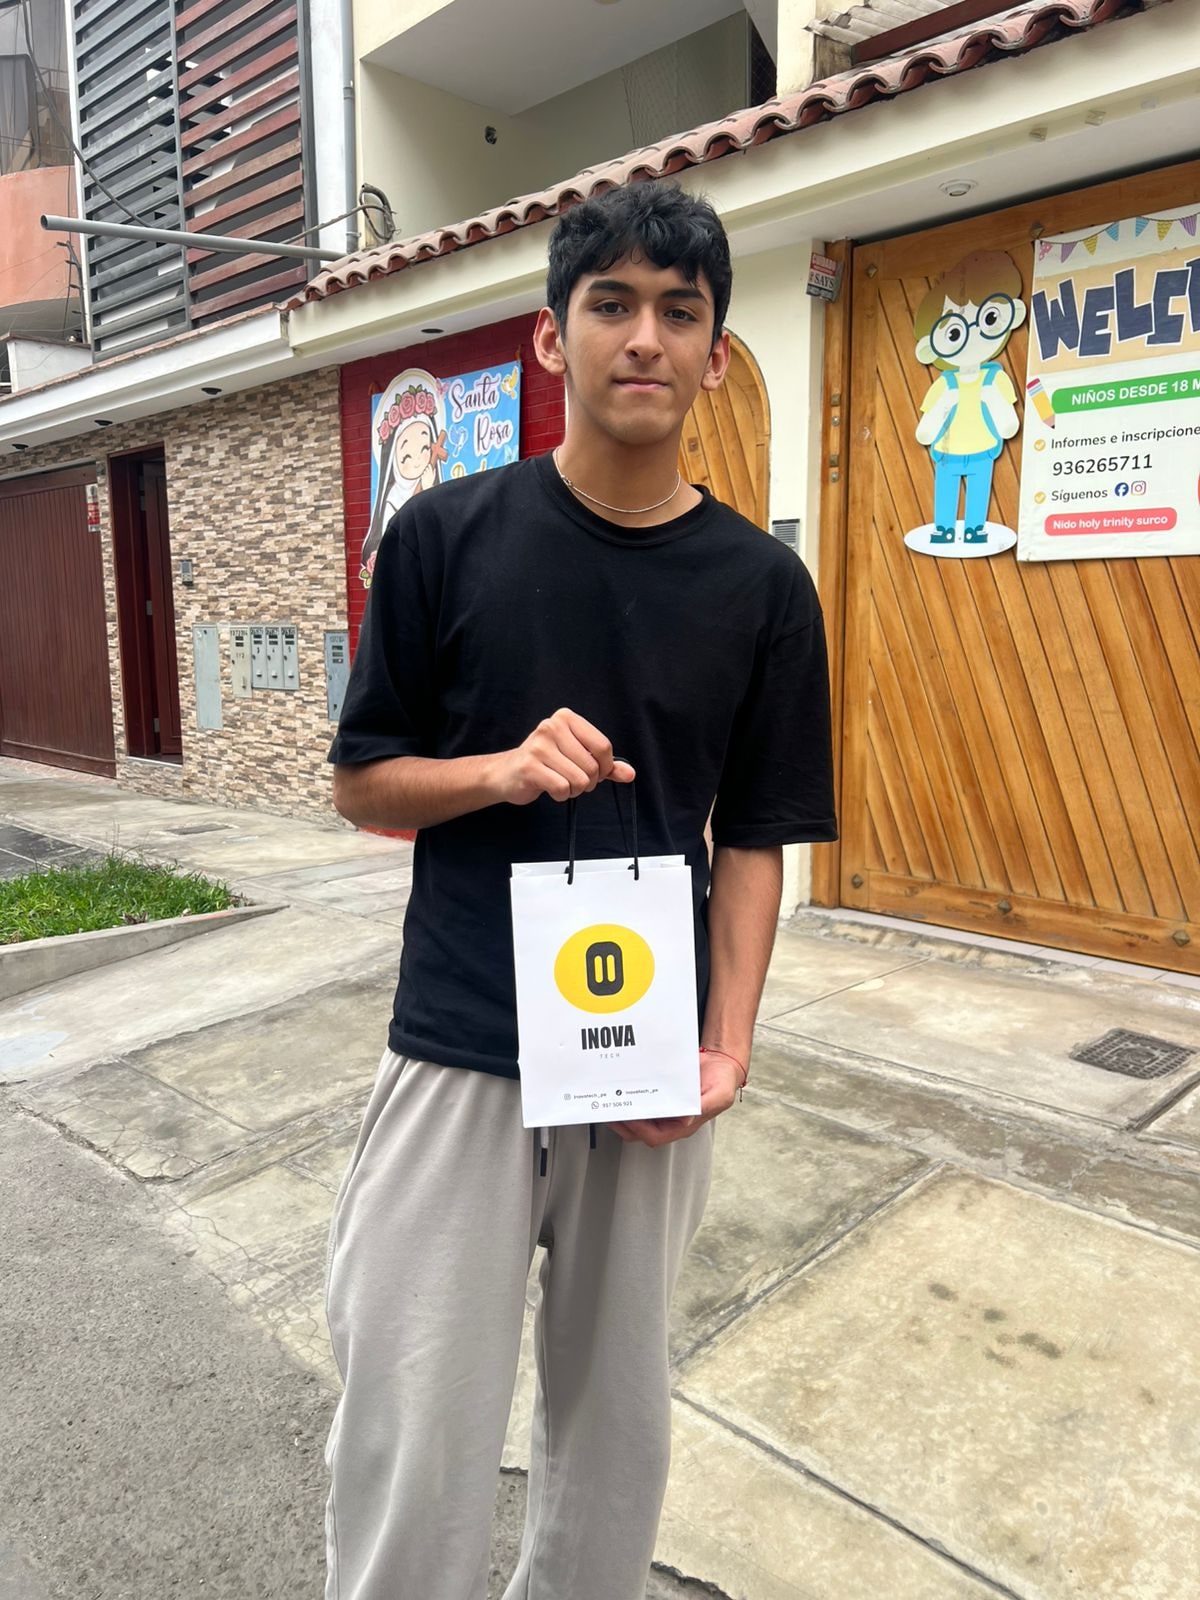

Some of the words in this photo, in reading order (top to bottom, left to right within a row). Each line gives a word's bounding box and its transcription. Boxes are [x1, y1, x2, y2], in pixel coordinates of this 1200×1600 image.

[451, 375, 500, 419] Santa
[1071, 389, 1115, 406] NIÑOS
[1119, 382, 1168, 400] DESDE
[1171, 379, 1188, 393] 18
[477, 416, 510, 452] Rosa
[1051, 435, 1106, 449] Informes
[1110, 434, 1118, 444] e
[1121, 425, 1200, 442] inscripcione
[1052, 454, 1152, 476] 936265711
[1051, 488, 1108, 503] Síguenos
[1053, 519, 1077, 530] Nido
[1078, 518, 1100, 530] holy
[1103, 516, 1134, 528] trinity
[1136, 515, 1168, 526] surco
[581, 1024, 636, 1050] INOVA
